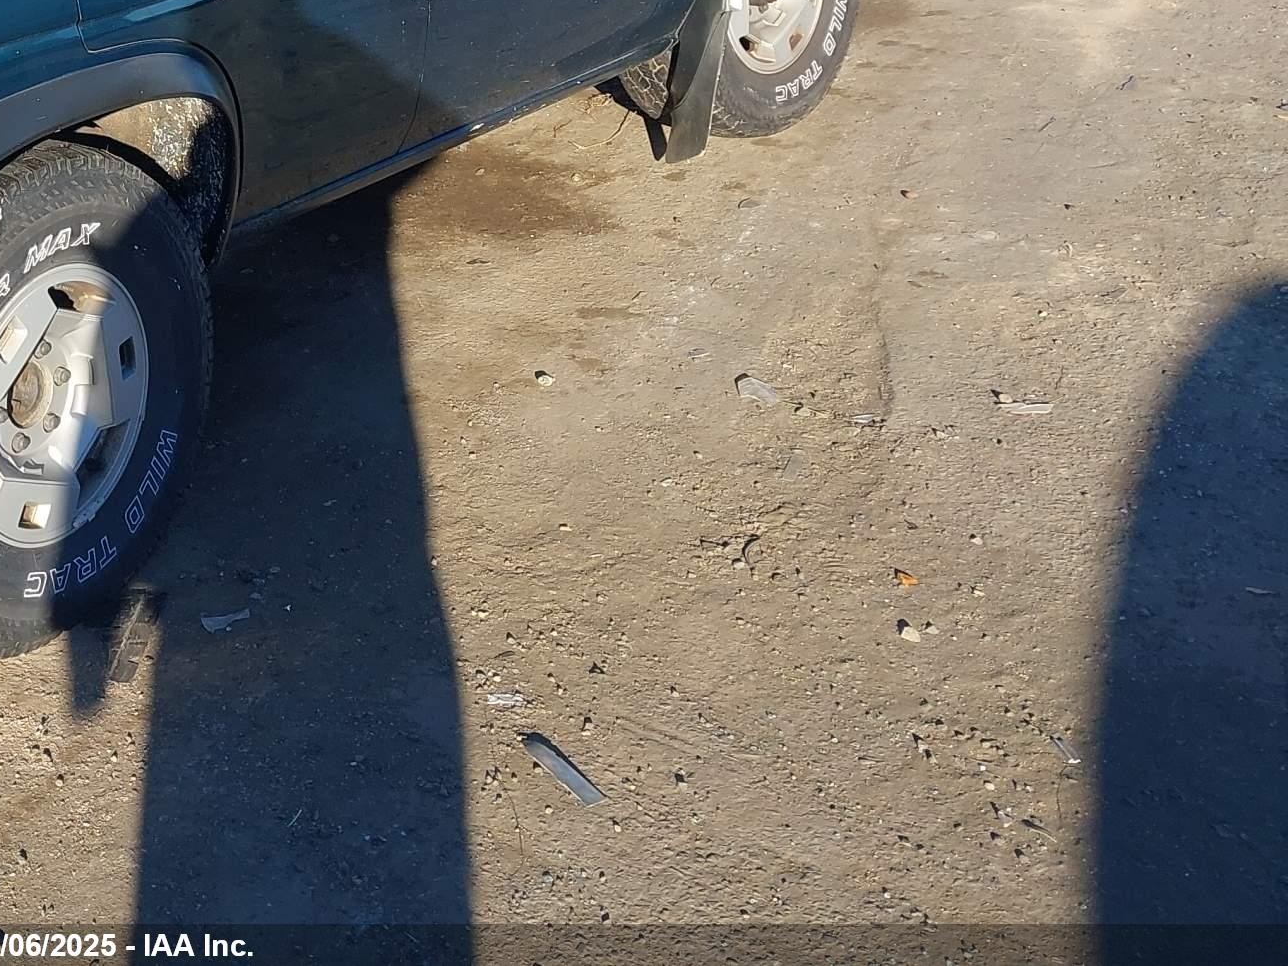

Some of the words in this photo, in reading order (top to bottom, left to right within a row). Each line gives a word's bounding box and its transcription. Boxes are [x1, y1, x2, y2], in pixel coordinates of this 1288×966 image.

[775, 60, 824, 102] TRAC
[23, 222, 101, 274] MAX
[125, 430, 178, 534] WILD
[23, 536, 118, 598] TRAC
